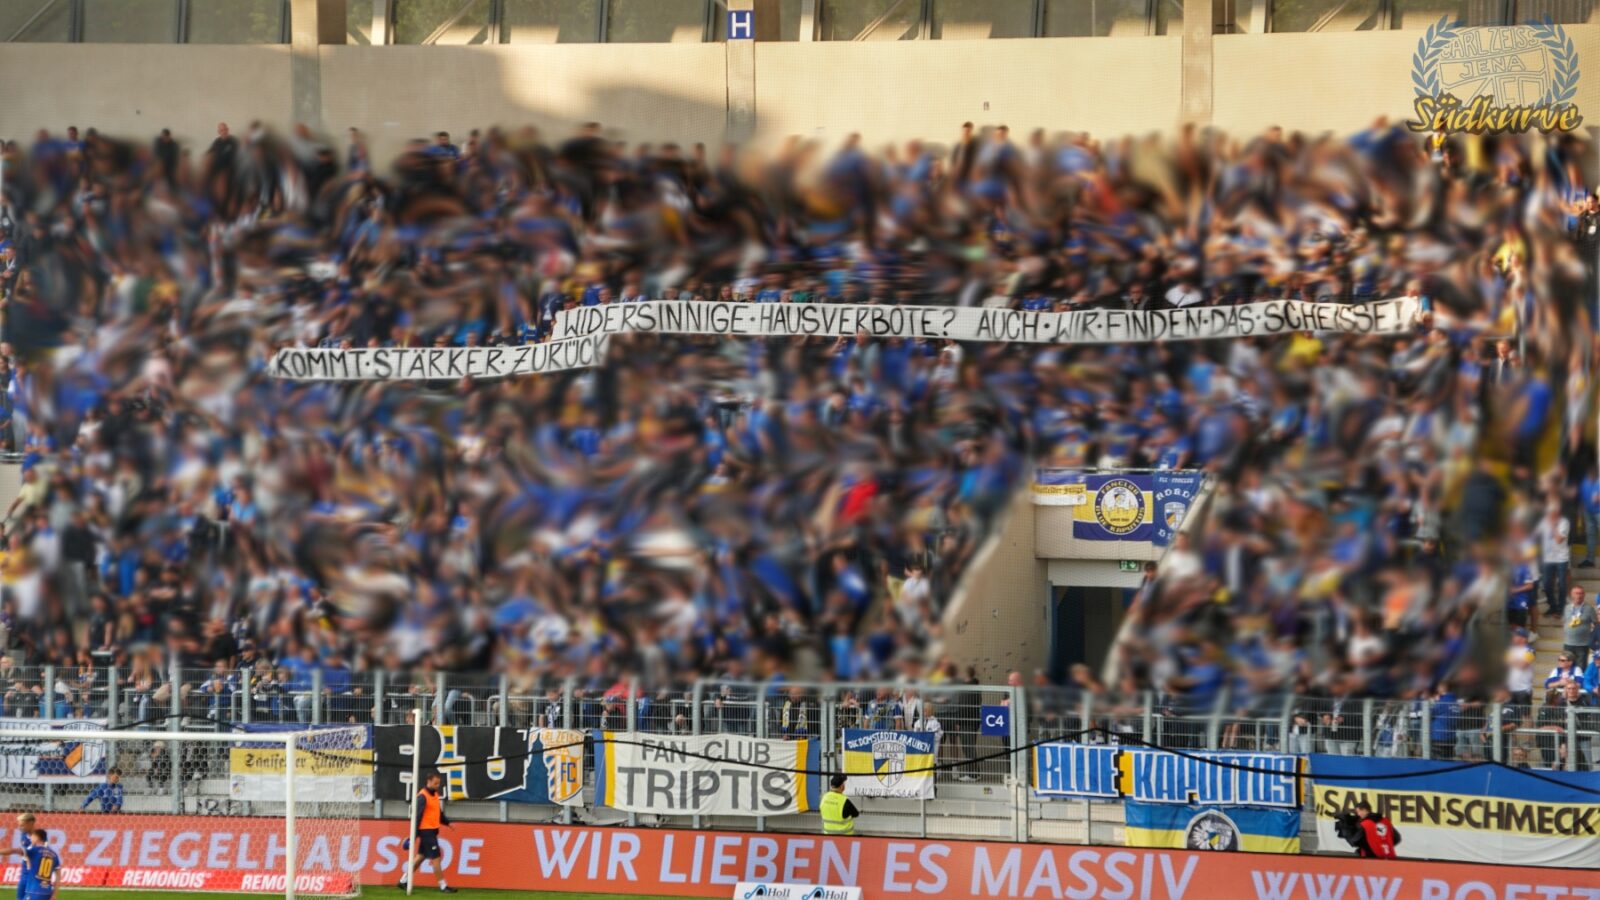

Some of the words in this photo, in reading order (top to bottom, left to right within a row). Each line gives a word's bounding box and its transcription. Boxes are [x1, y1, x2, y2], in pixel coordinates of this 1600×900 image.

[731, 12, 751, 38] H
[564, 302, 749, 336] WIDERSINNIGE
[759, 304, 957, 336] HAUSVERBOTE?
[976, 310, 1037, 341] AUCH
[1055, 311, 1097, 340] WIR
[1106, 309, 1201, 339] FINDEN
[1211, 307, 1254, 334] DAS
[276, 349, 367, 378] KOMMT
[373, 349, 502, 378] STÄRKER
[512, 334, 608, 375] ZURÜCK
[985, 714, 1005, 727] C4
[561, 762, 576, 782] FC
[1037, 745, 1119, 797] BLUE
[618, 766, 793, 812] TRIPTIS
[1446, 798, 1600, 835] SCHMECK
[4, 867, 83, 883] REDIS
[38, 857, 53, 877] 10
[533, 829, 641, 882] WIR
[659, 834, 860, 887] LIEBEN
[883, 843, 952, 894] ES
[971, 847, 1200, 900] MASSIV
[122, 870, 205, 887] REMONDIS
[768, 888, 790, 897] Holl
[825, 891, 848, 900] Holl
